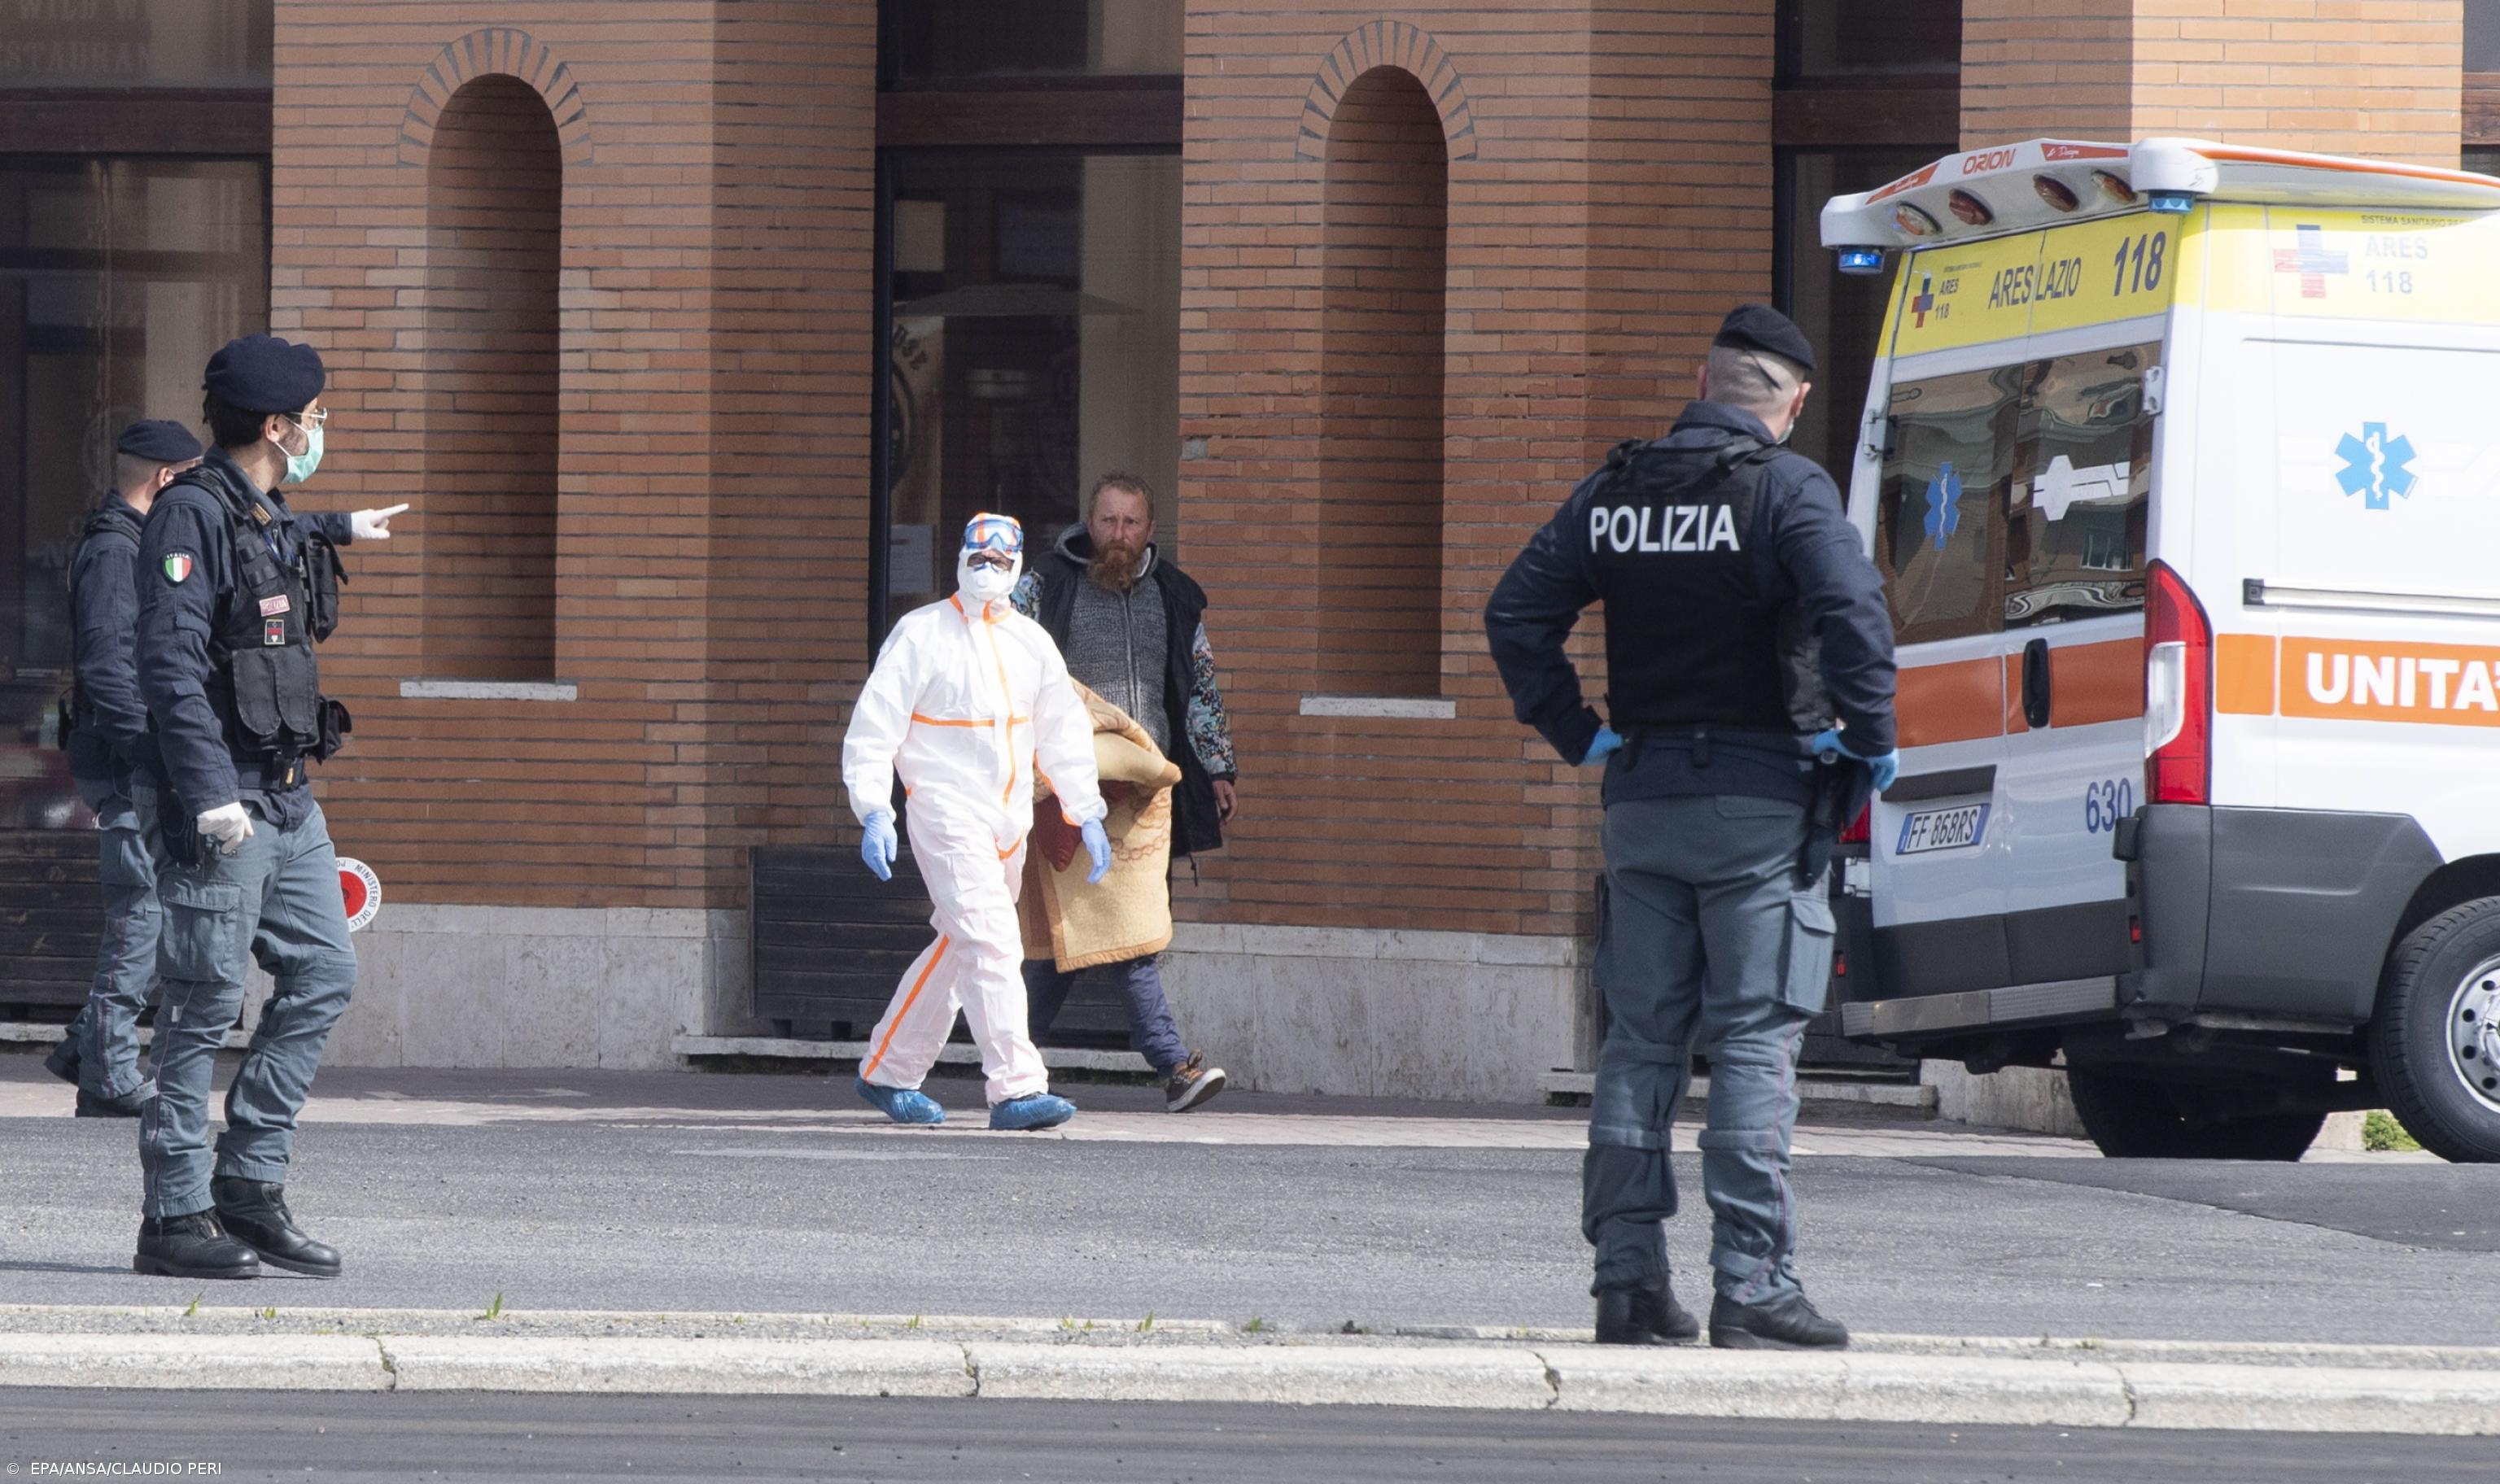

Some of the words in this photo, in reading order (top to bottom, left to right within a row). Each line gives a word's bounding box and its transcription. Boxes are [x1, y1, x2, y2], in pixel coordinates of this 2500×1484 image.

[0, 40, 150, 73] STAURAN
[1962, 147, 2017, 175] ORION
[2361, 215, 2399, 225] SISTEMA
[2113, 231, 2166, 297] 118
[2365, 235, 2428, 260] ARES
[1939, 277, 1960, 296] ARES
[1987, 264, 2035, 310] ARES
[2035, 256, 2082, 301] LAZIO
[2365, 269, 2413, 295] 118
[1935, 302, 1950, 320] 118
[1590, 504, 1741, 553] POLIZIA
[2306, 652, 2500, 712] UNITA
[2086, 778, 2132, 834] 630
[1907, 815, 1931, 849] FF
[1930, 809, 1978, 846] 868RS
[355, 864, 378, 908] MINISTERO
